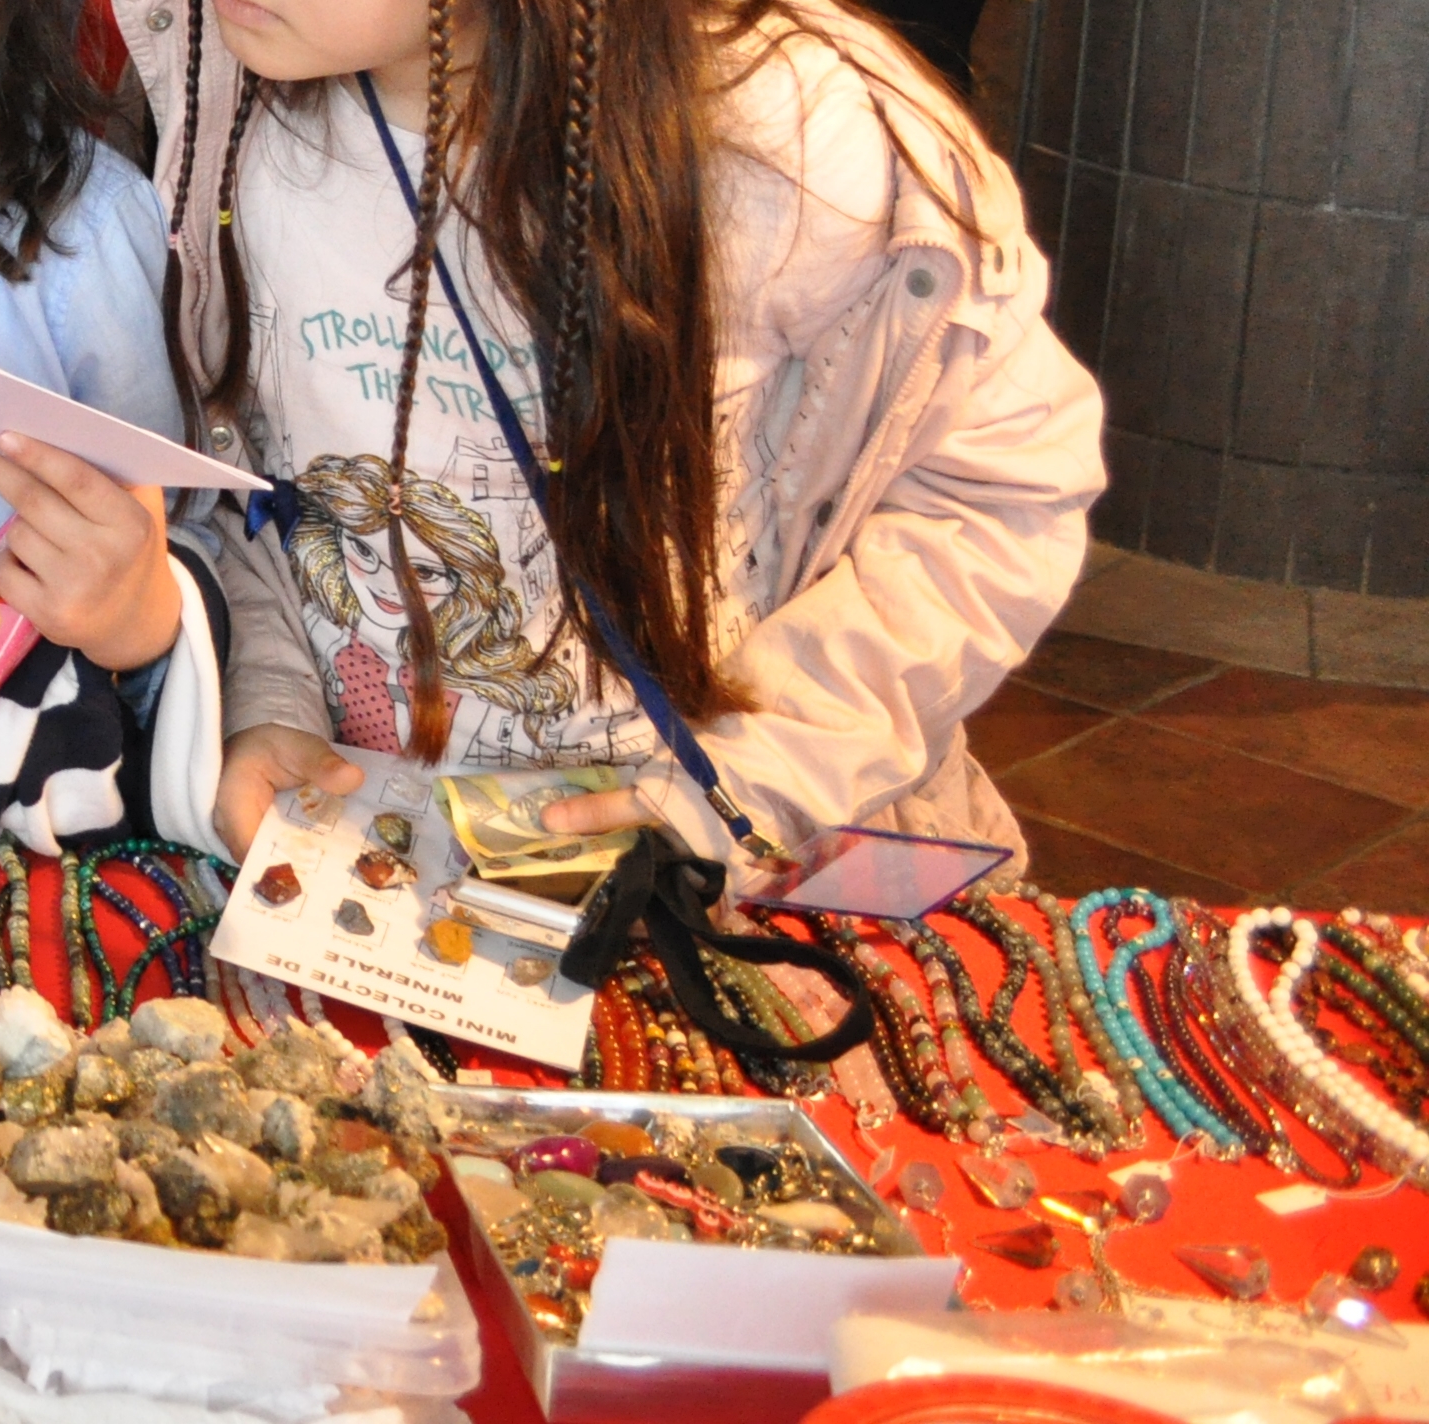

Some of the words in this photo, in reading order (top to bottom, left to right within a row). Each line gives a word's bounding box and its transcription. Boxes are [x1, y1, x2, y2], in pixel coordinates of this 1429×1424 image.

[301, 309, 469, 372] STROLLNG
[345, 362, 420, 406] TH
[265, 952, 302, 974] DE
[323, 949, 464, 1005] MINERALE
[310, 967, 447, 1022] COLECTIE
[455, 1016, 518, 1045] MINI
